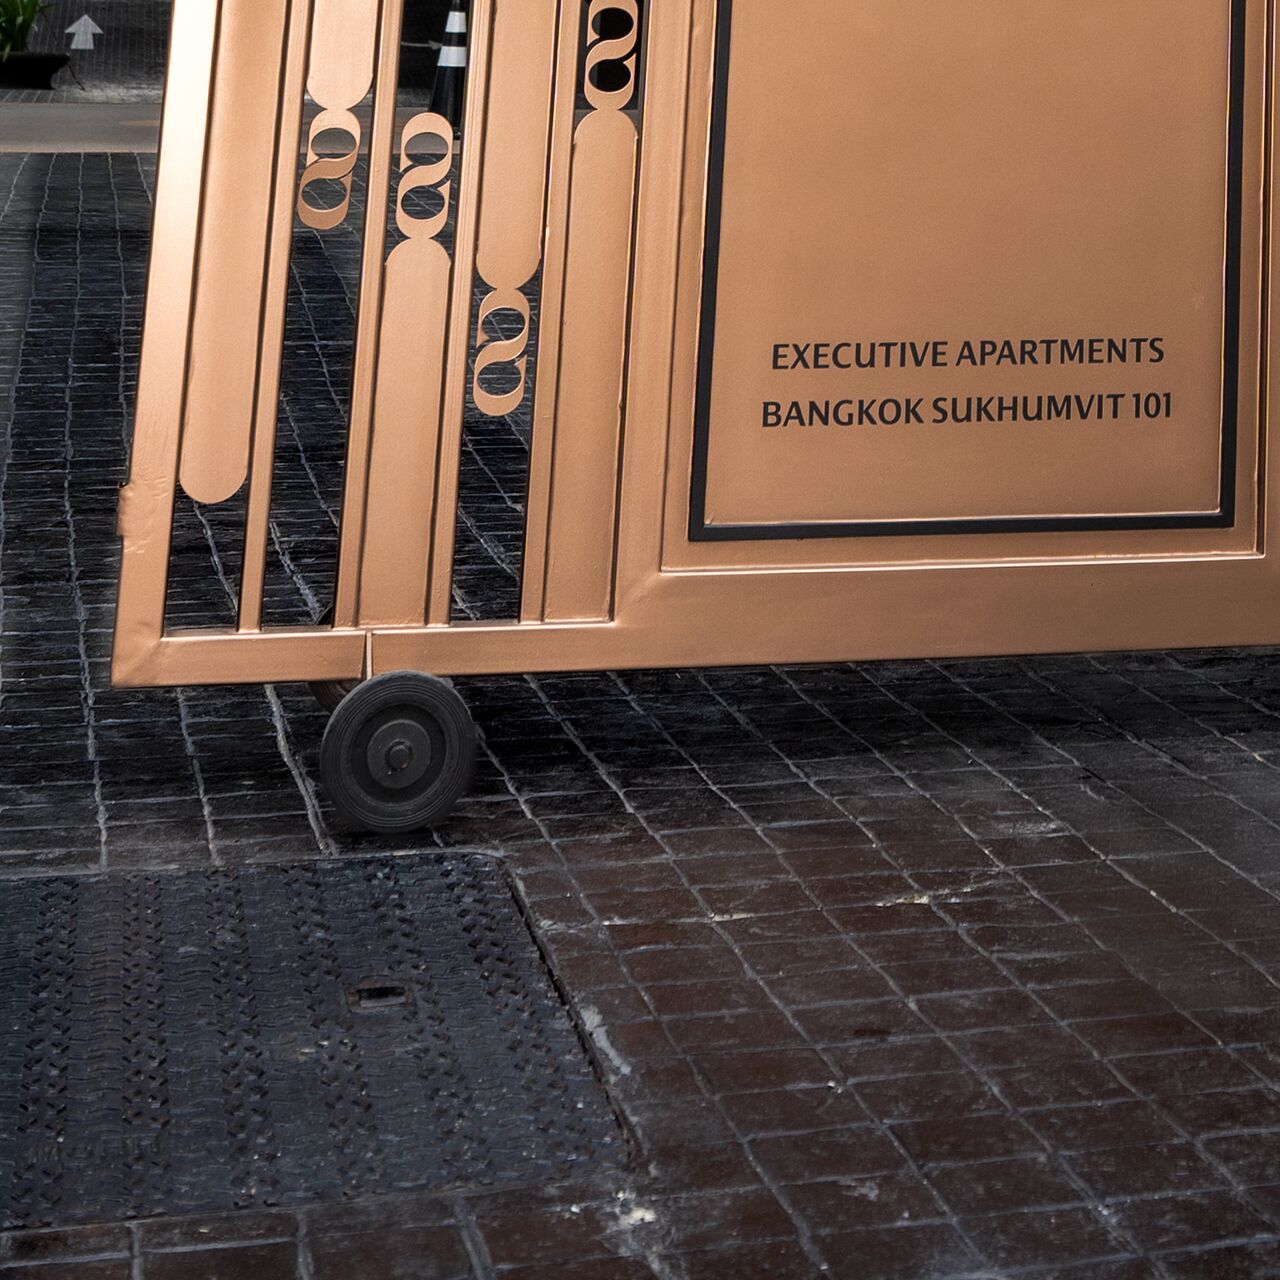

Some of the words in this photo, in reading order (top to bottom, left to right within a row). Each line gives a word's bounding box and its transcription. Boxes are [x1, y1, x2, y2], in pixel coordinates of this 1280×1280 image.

[772, 340, 949, 370] EXECUTIVE
[955, 337, 1165, 367] APARTMENTS
[762, 398, 924, 428] BANGKOK
[932, 393, 1126, 424] SUKHUMVIT
[1132, 391, 1172, 420] 101
